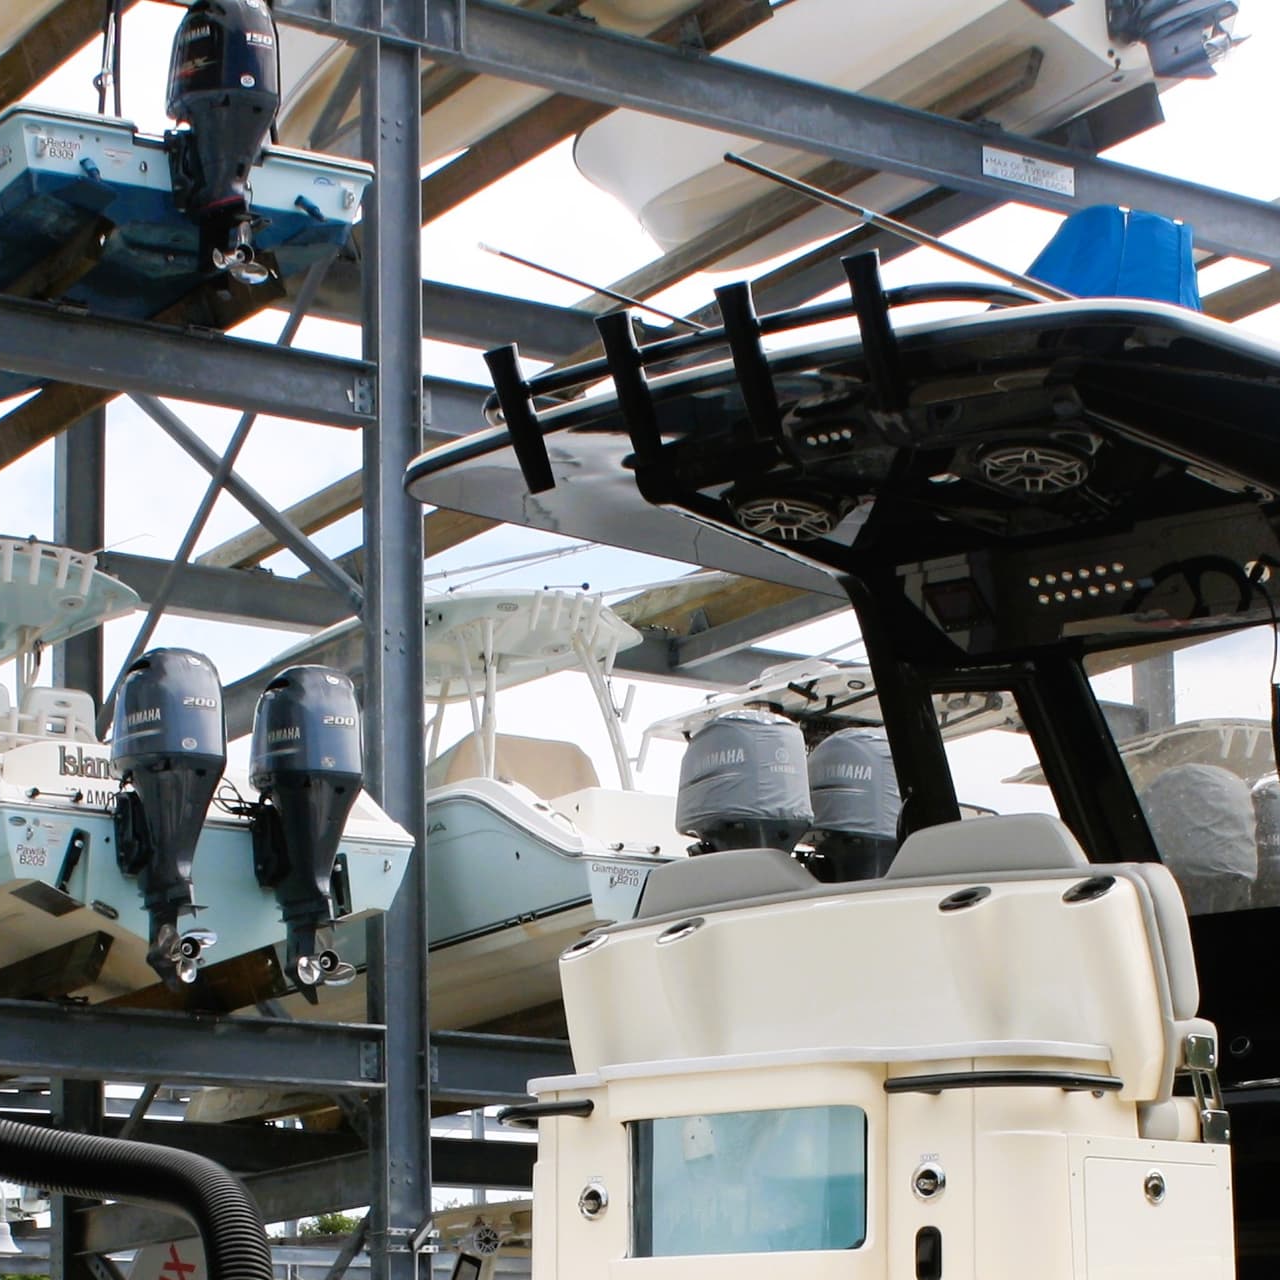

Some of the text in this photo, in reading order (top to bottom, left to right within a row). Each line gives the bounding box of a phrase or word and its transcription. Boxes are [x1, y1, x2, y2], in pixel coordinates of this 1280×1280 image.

[245, 31, 273, 46] 150
[46, 136, 81, 151] Reddin
[49, 148, 75, 161] B309
[183, 695, 217, 708] 200
[128, 707, 161, 726] YAMAHA
[323, 715, 355, 727] 200
[267, 727, 301, 744] YAMAHA
[19, 855, 46, 867] B209
